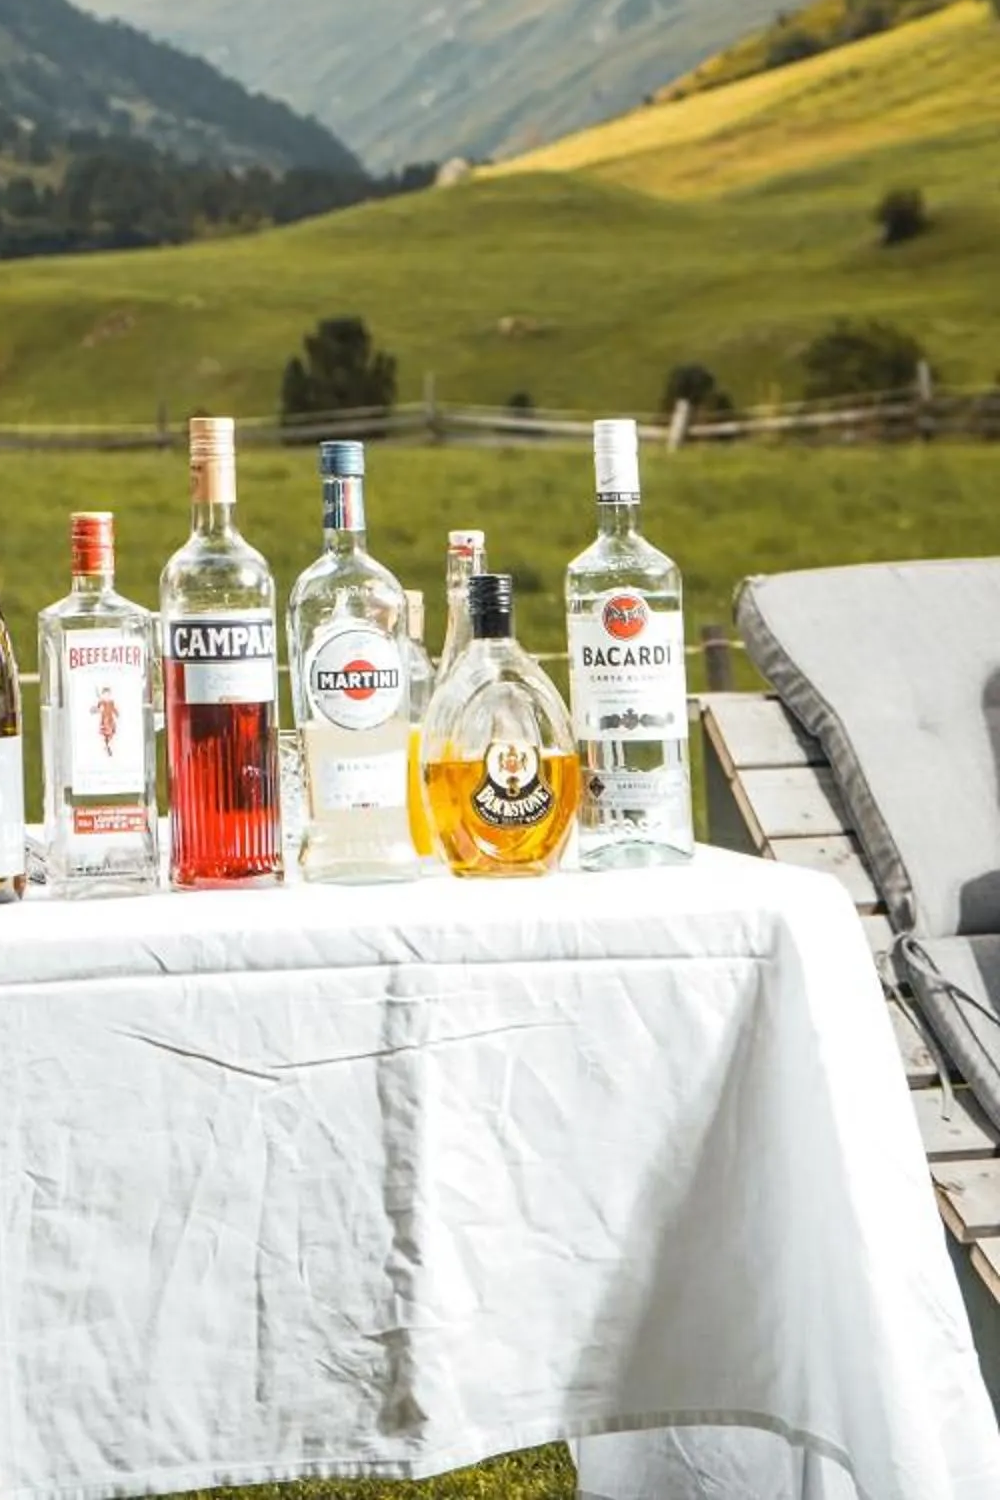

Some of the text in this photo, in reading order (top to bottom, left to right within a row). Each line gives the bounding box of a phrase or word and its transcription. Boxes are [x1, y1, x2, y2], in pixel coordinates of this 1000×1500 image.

[69, 646, 141, 670] BEEFEATER
[583, 645, 671, 667] BACARDI
[320, 670, 397, 689] MARTINI
